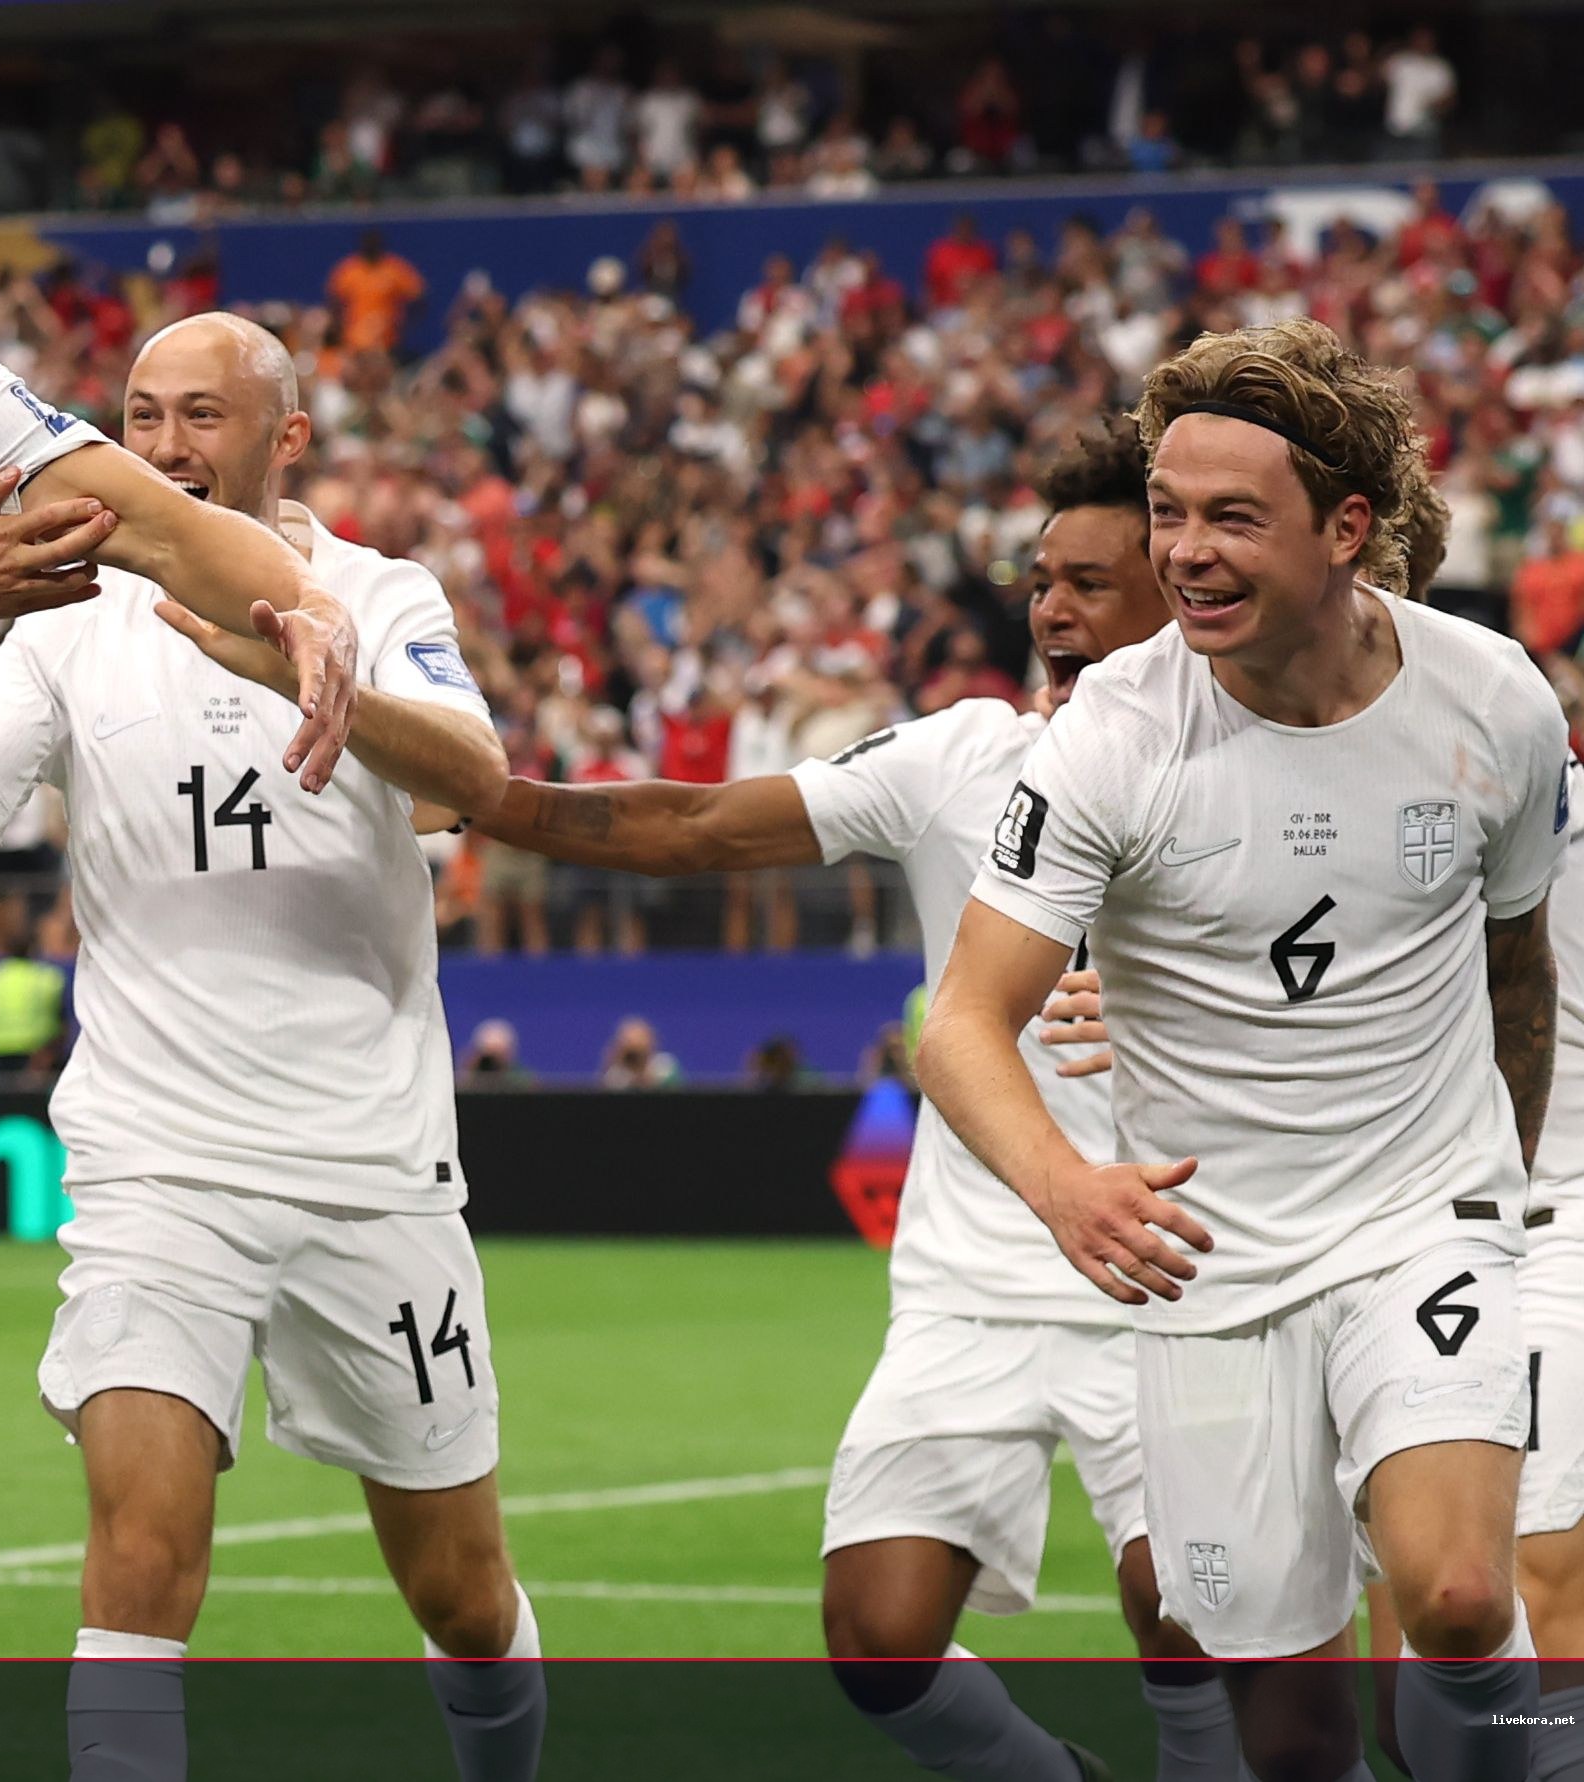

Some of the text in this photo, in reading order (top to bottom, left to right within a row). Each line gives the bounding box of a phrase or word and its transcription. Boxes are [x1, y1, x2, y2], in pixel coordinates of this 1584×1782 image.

[178, 765, 272, 872] 14
[1293, 845, 1327, 857] DALLAS
[1269, 893, 1337, 1002] 6
[388, 1287, 476, 1405] 14
[1416, 1270, 1480, 1356] 6
